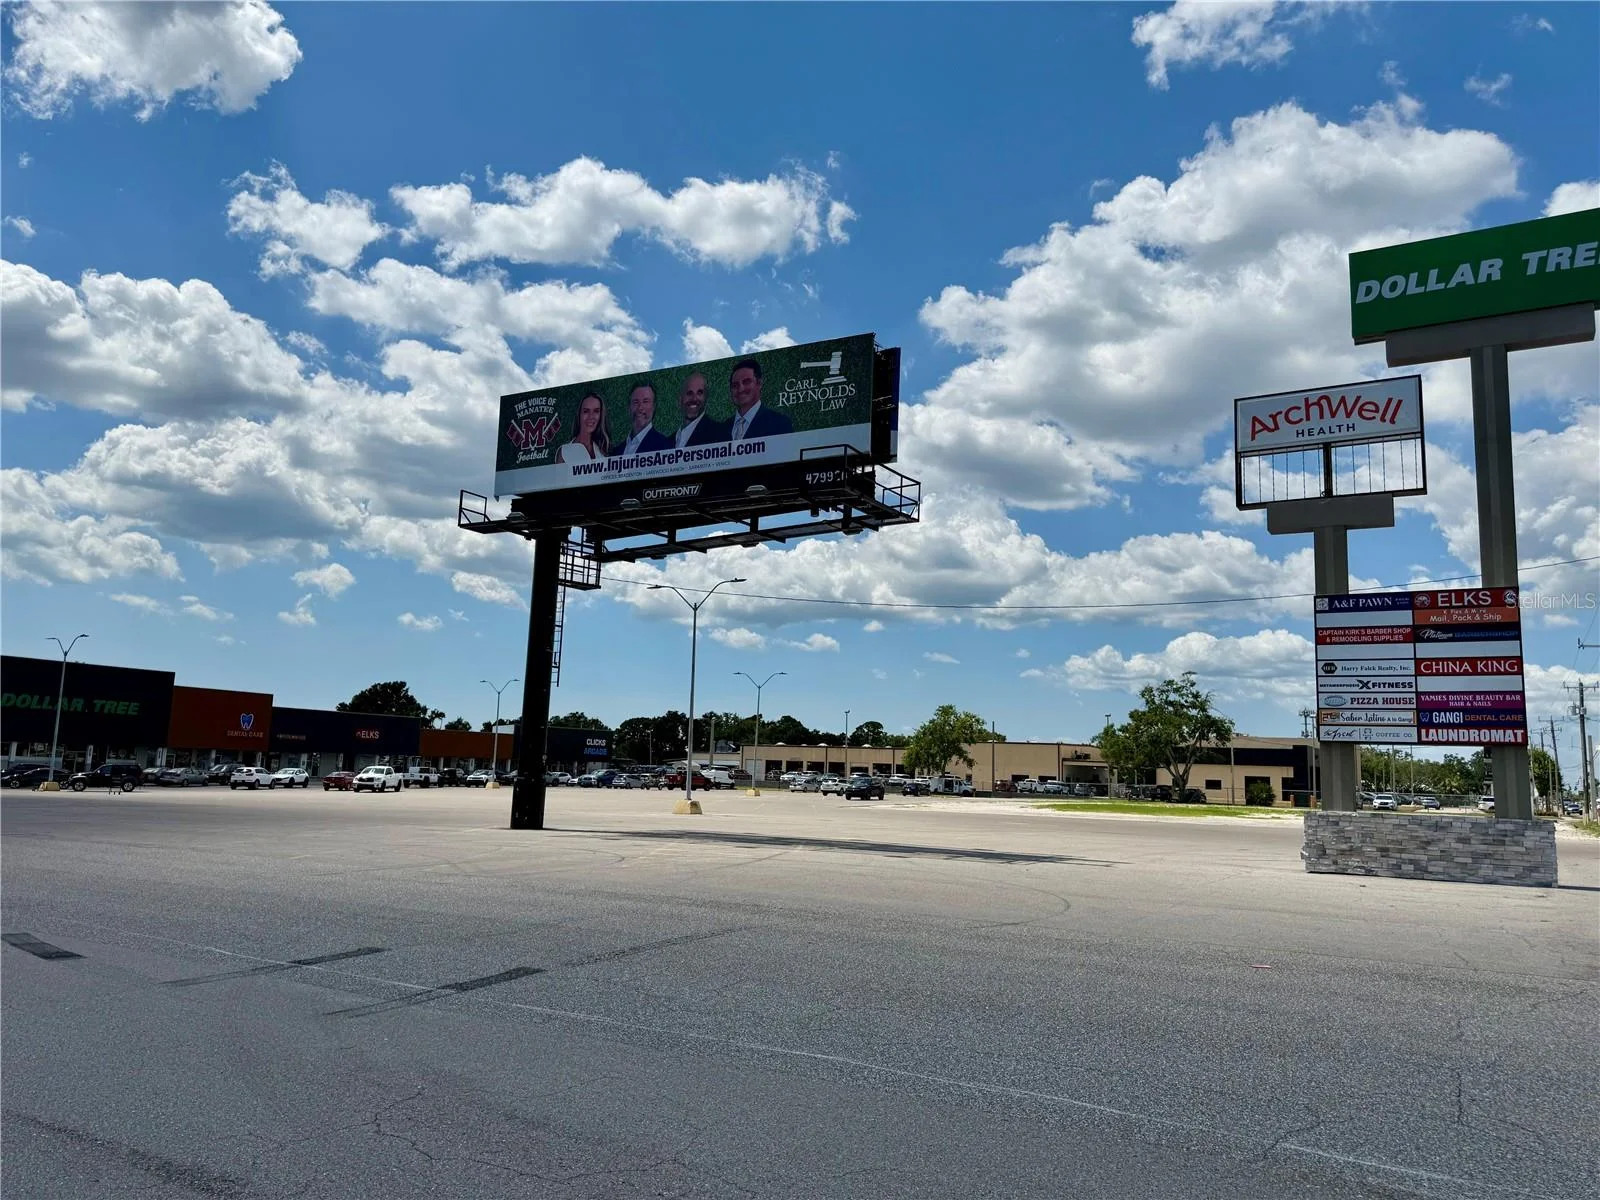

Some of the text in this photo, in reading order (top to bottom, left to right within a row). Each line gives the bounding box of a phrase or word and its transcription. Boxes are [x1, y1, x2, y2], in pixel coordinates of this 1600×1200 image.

[1355, 242, 1600, 304] DOLLAR TRE
[785, 378, 817, 392] CARL
[777, 383, 856, 407] REYNOLDS
[514, 396, 557, 412] THE VOICE OF
[820, 398, 847, 412] LAW
[516, 405, 555, 419] MANATEE
[1250, 394, 1403, 442] ArchWell
[521, 416, 547, 450] M
[1296, 422, 1356, 439] HEALTH
[516, 449, 549, 464] Football
[572, 440, 766, 476] www.InjuriesArePersonal.com
[1332, 598, 1356, 609] A&F
[1359, 596, 1392, 608] PAWN
[1437, 591, 1492, 607] ELKS
[1452, 614, 1472, 622] Pack
[1483, 613, 1502, 622] Ship
[1366, 627, 1392, 635] BARBER
[1331, 635, 1372, 643] REMODELING
[1373, 634, 1404, 642] SUPPLIES
[1420, 660, 1518, 673] CHINA KING
[1371, 681, 1413, 689] FITNESS
[1, 693, 140, 715] DOLLAR TREE
[1350, 697, 1379, 705] PIZZA
[1382, 697, 1415, 705] HOUSE
[1432, 711, 1464, 724] GANGI
[361, 730, 380, 739] ELKS
[1420, 728, 1524, 743] LAUNDROMAT
[586, 738, 606, 746] CLICKS
